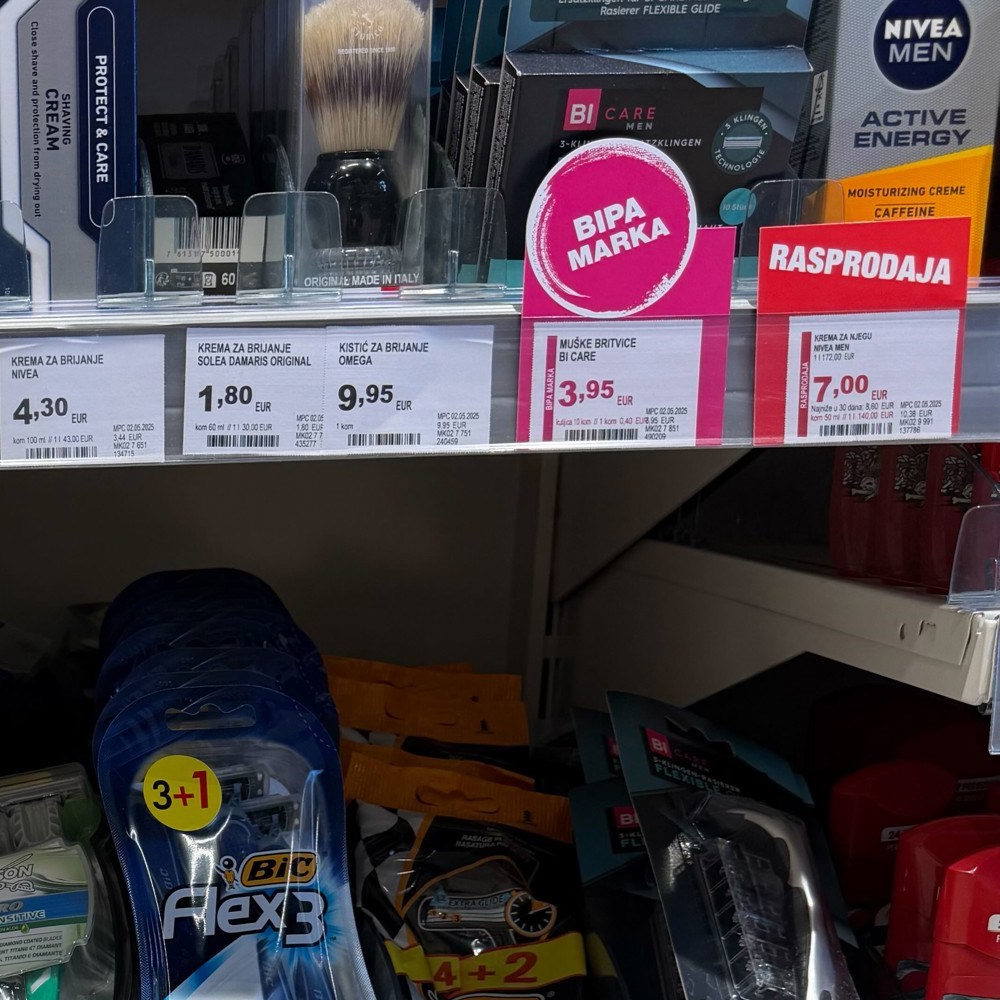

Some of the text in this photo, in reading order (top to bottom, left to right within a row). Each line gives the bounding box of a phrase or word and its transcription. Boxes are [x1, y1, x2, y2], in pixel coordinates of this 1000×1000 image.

[600, 3, 721, 16] Rasierer FLEXIBLE GLIDE
[884, 17, 963, 40] NIVEA
[31, 49, 39, 77] shave
[888, 42, 953, 63] MEN
[32, 99, 40, 145] protection
[45, 88, 59, 151] CREAM
[61, 93, 71, 145] SHAVING
[95, 55, 108, 183] PROTECT & CARE
[569, 103, 656, 125] BI CARE
[859, 109, 967, 128] ACTIVE
[626, 122, 653, 131] MEN
[854, 129, 971, 149] ENERGY
[714, 149, 766, 172] TECHNOLOGIE
[32, 172, 42, 203] drying
[847, 185, 966, 198] MOISTURIZING CREME
[573, 196, 647, 242] BIPA
[874, 206, 935, 218] CAFFEINE
[567, 216, 671, 272] MARKA
[768, 243, 952, 286] RASPRODAJA
[221, 273, 236, 286] 60
[304, 273, 420, 287] ORIGINAL MADE IN ITALY
[339, 340, 429, 353] KISTIĆ ZA BRIJANJE
[560, 336, 637, 349] MUŠKE BRITVICE
[814, 332, 872, 342] KREMA ZA NJEGU
[814, 343, 850, 352] NIVEA MEN
[12, 354, 104, 366] KREMA ZA BRIJANJE
[197, 356, 311, 366] SOLEA DAMARIS ORIGINAL
[339, 355, 372, 366] OMEGA
[12, 369, 39, 379] NIVEA
[198, 385, 253, 412] 1,80
[338, 384, 412, 411] 9,95 EUR
[558, 380, 614, 407] 3,95
[813, 374, 869, 403] 7,00
[13, 398, 68, 425] 4,30
[152, 770, 209, 811] 3+1
